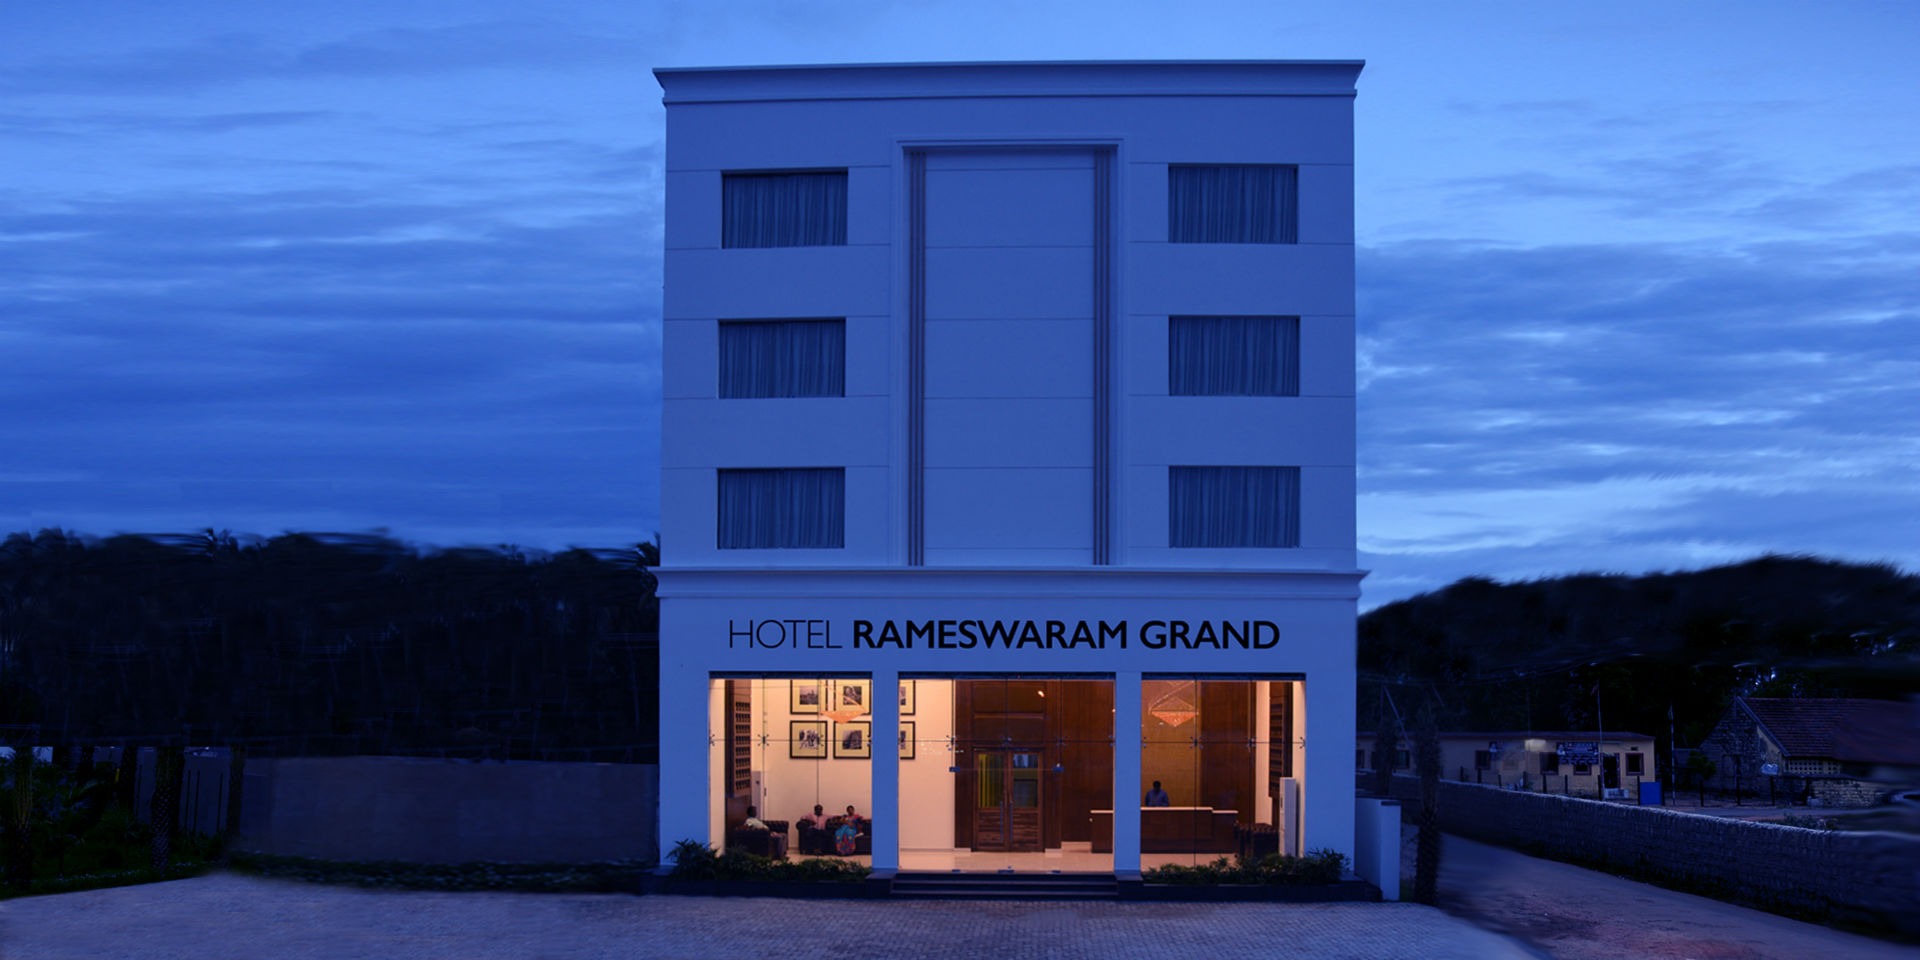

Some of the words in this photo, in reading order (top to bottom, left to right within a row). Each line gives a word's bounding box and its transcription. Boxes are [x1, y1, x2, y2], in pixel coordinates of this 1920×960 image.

[729, 619, 843, 649] HOTEL
[853, 619, 1128, 649] RAMESWARAM
[1139, 619, 1281, 650] GRAND
